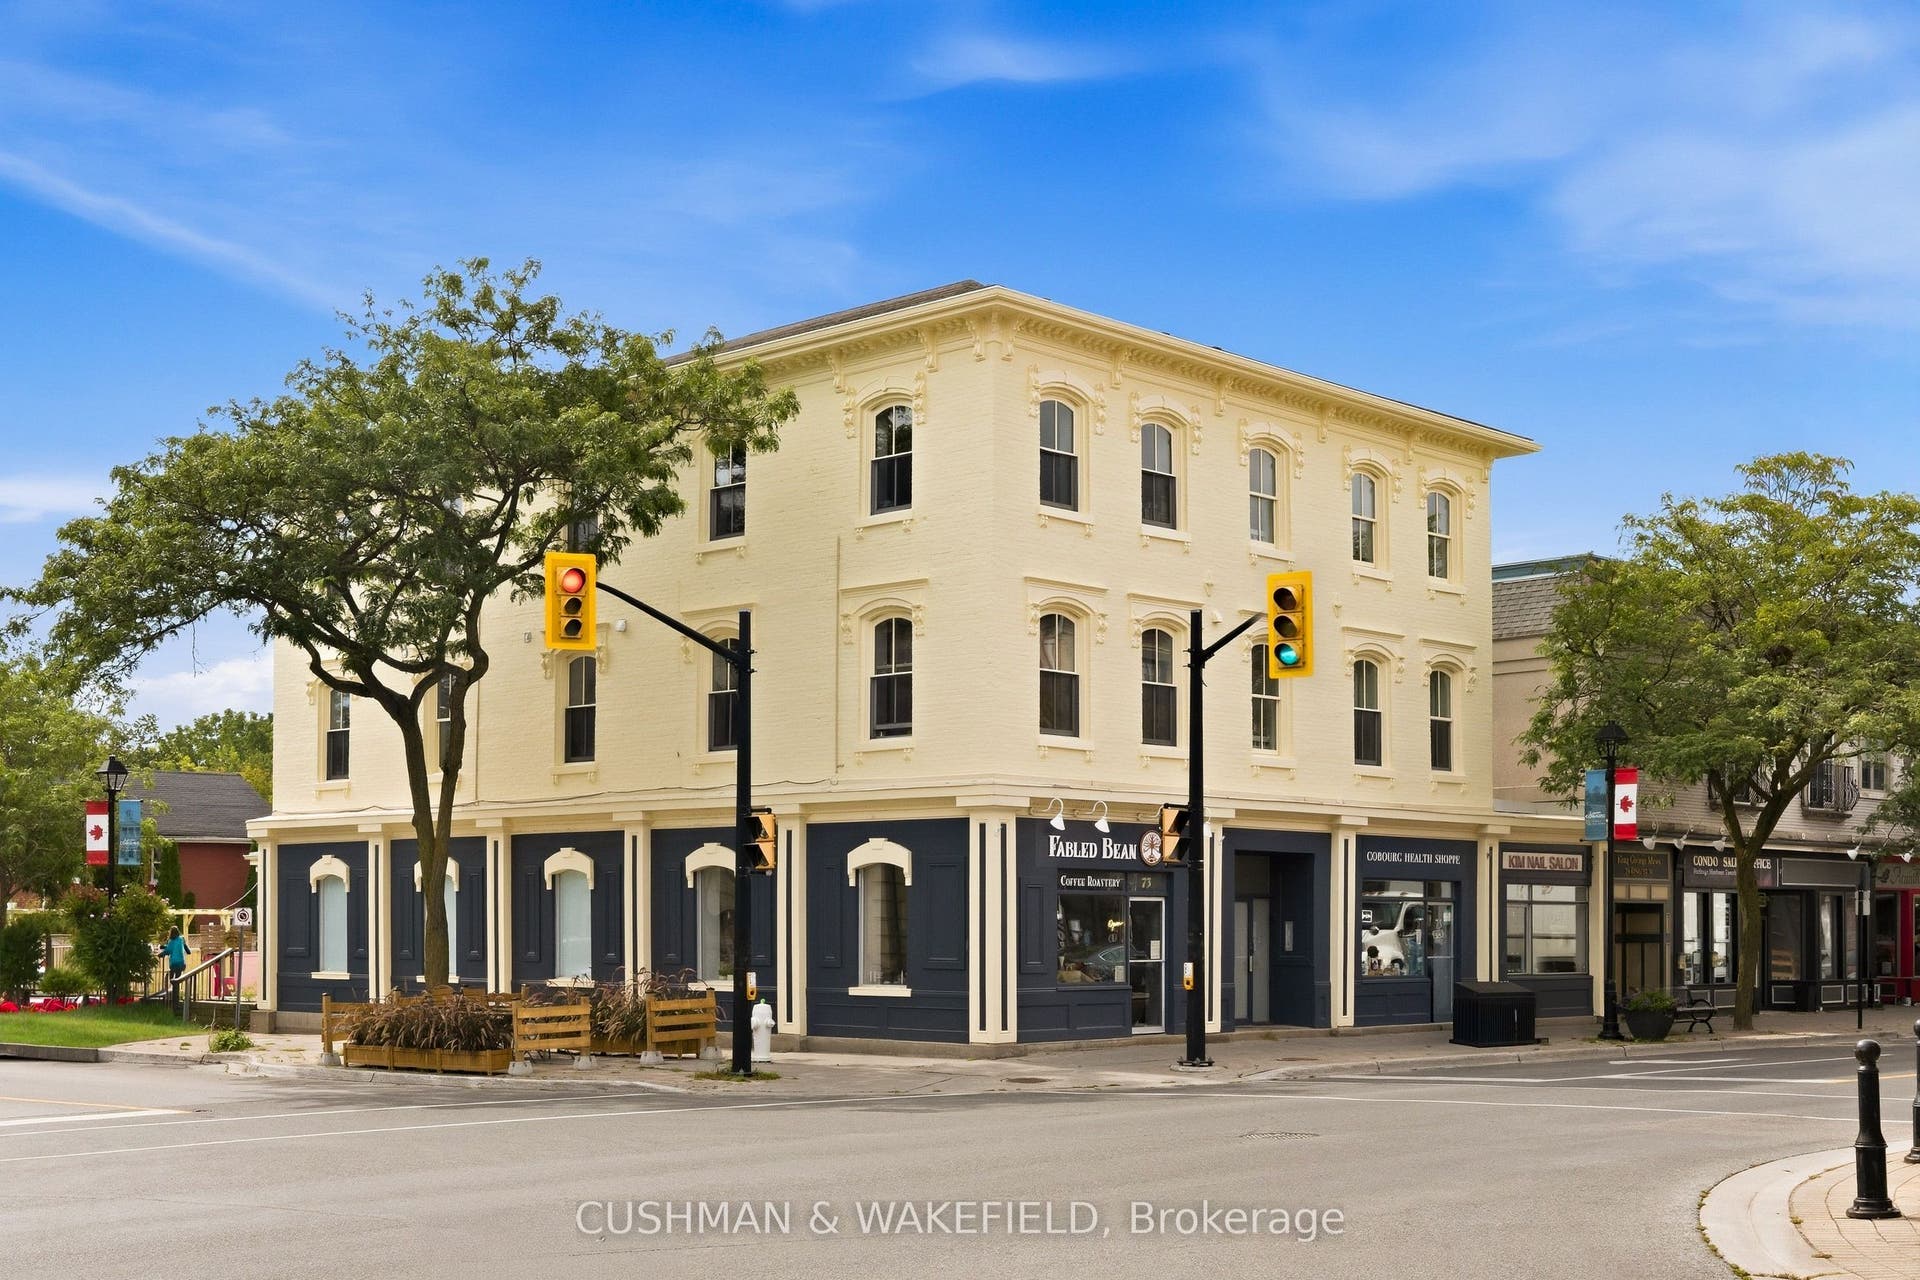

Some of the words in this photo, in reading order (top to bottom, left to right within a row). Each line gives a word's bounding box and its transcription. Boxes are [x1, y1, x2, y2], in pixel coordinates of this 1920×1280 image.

[1048, 834, 1098, 859] FABLED
[1102, 837, 1137, 860] BEAN
[1404, 852, 1433, 864] HEALTH
[1434, 854, 1461, 865] SHOPPE
[1508, 855, 1525, 868] KIM
[1527, 855, 1547, 869] NAIL
[1549, 856, 1579, 870] SALON
[1693, 855, 1719, 867] CONDO
[1723, 856, 1737, 868] SAL
[1060, 874, 1086, 887] COFFEE
[1087, 875, 1121, 888] ROASTERY
[1141, 877, 1152, 889] 73
